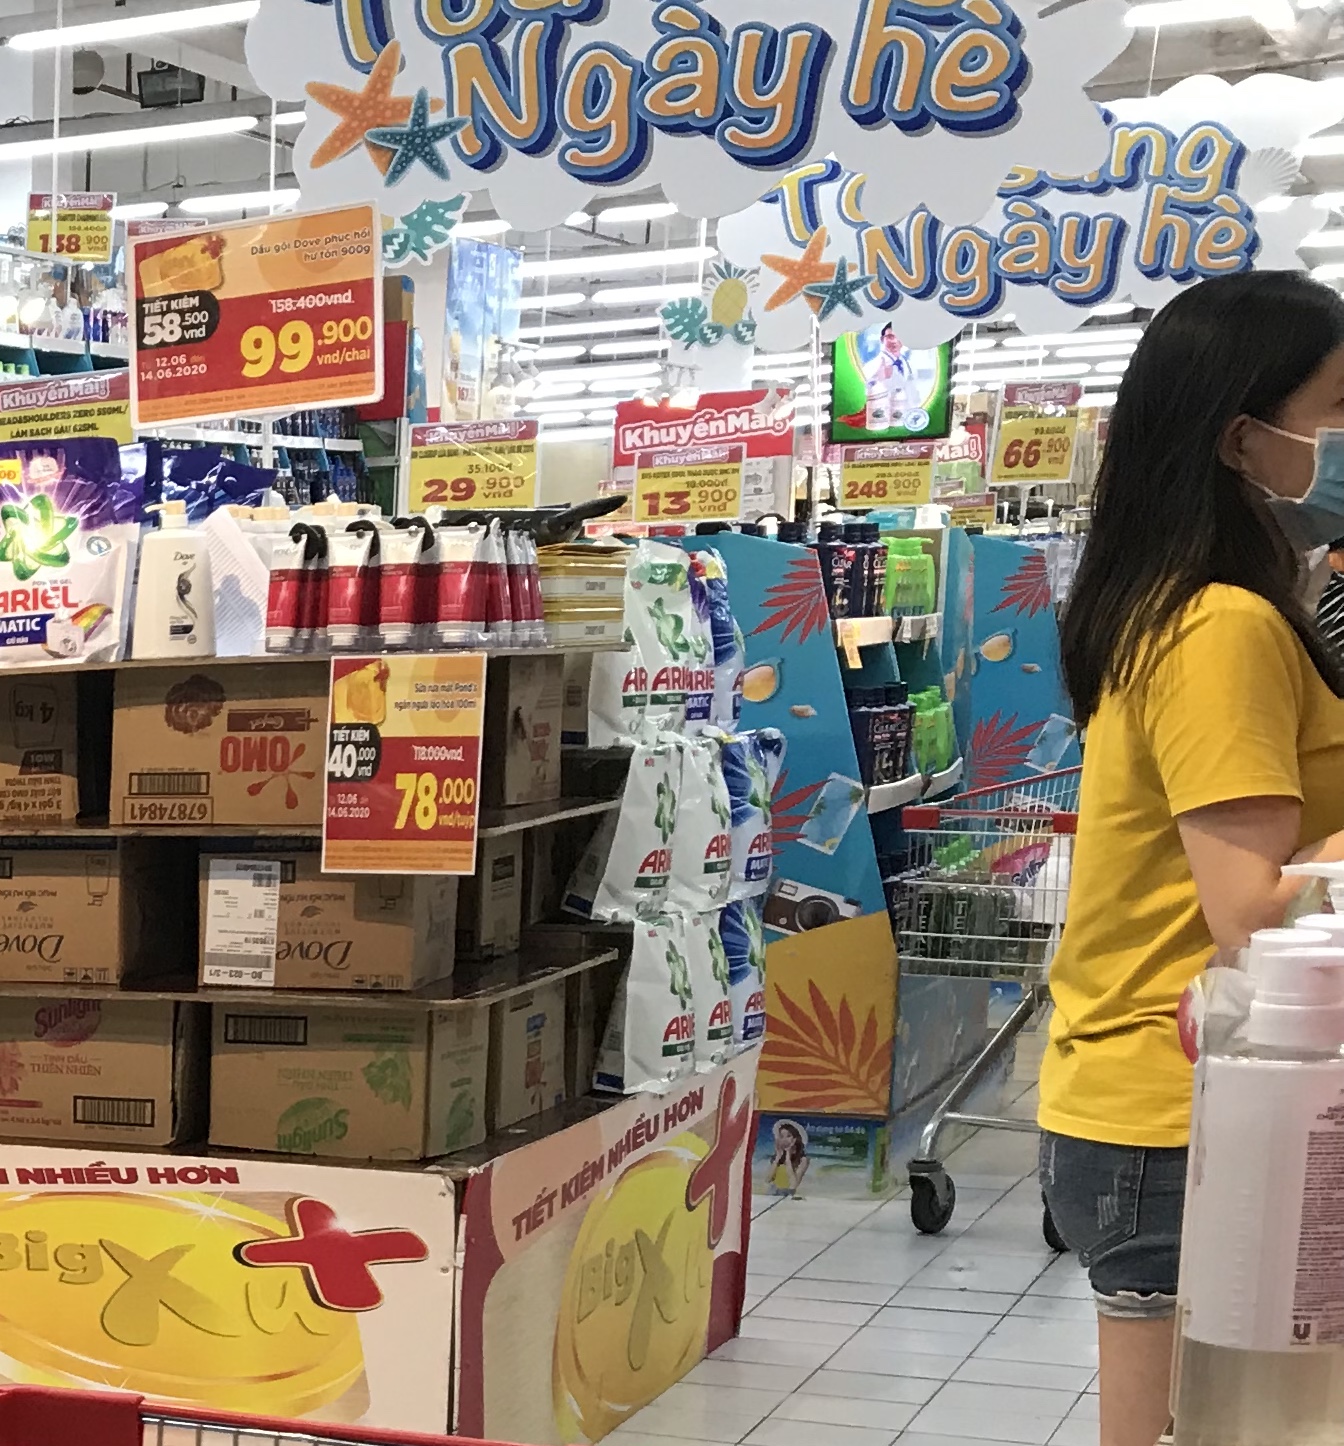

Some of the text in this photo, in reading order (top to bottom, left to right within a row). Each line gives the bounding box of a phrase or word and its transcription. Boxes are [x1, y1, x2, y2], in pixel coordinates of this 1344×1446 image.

[447, 2, 833, 184] Ngày
[842, 0, 1028, 132] hè
[294, 236, 321, 250] Dove
[341, 243, 371, 257] 900g
[859, 200, 1129, 318] Ngày
[1138, 183, 1260, 280] hè
[142, 297, 168, 315] TIẾT
[142, 310, 209, 346] 58 .500
[240, 315, 373, 378] 99 .900
[316, 346, 371, 366] vnd/chai
[155, 354, 187, 366] 12.06
[140, 364, 208, 381] 14.06.2020
[73, 407, 95, 418] ZERO
[1003, 439, 1041, 469] 66
[422, 477, 476, 502] 29
[845, 480, 888, 499] 248
[642, 490, 691, 516] 13
[174, 551, 197, 561] Dove
[333, 726, 350, 741] TIẾT
[220, 735, 290, 773] OMO
[328, 743, 357, 778] 40
[337, 793, 358, 804] 12.06
[394, 772, 475, 830] 78 .000
[130, 802, 208, 821] 67874841
[328, 806, 370, 819] 14.06.2020
[276, 940, 353, 970] Dove
[15, 1158, 139, 1187] NHIỀU
[148, 1163, 239, 1186] HƠN
[512, 1086, 705, 1242] TIẾT KIỆM NHIỀU HƠN
